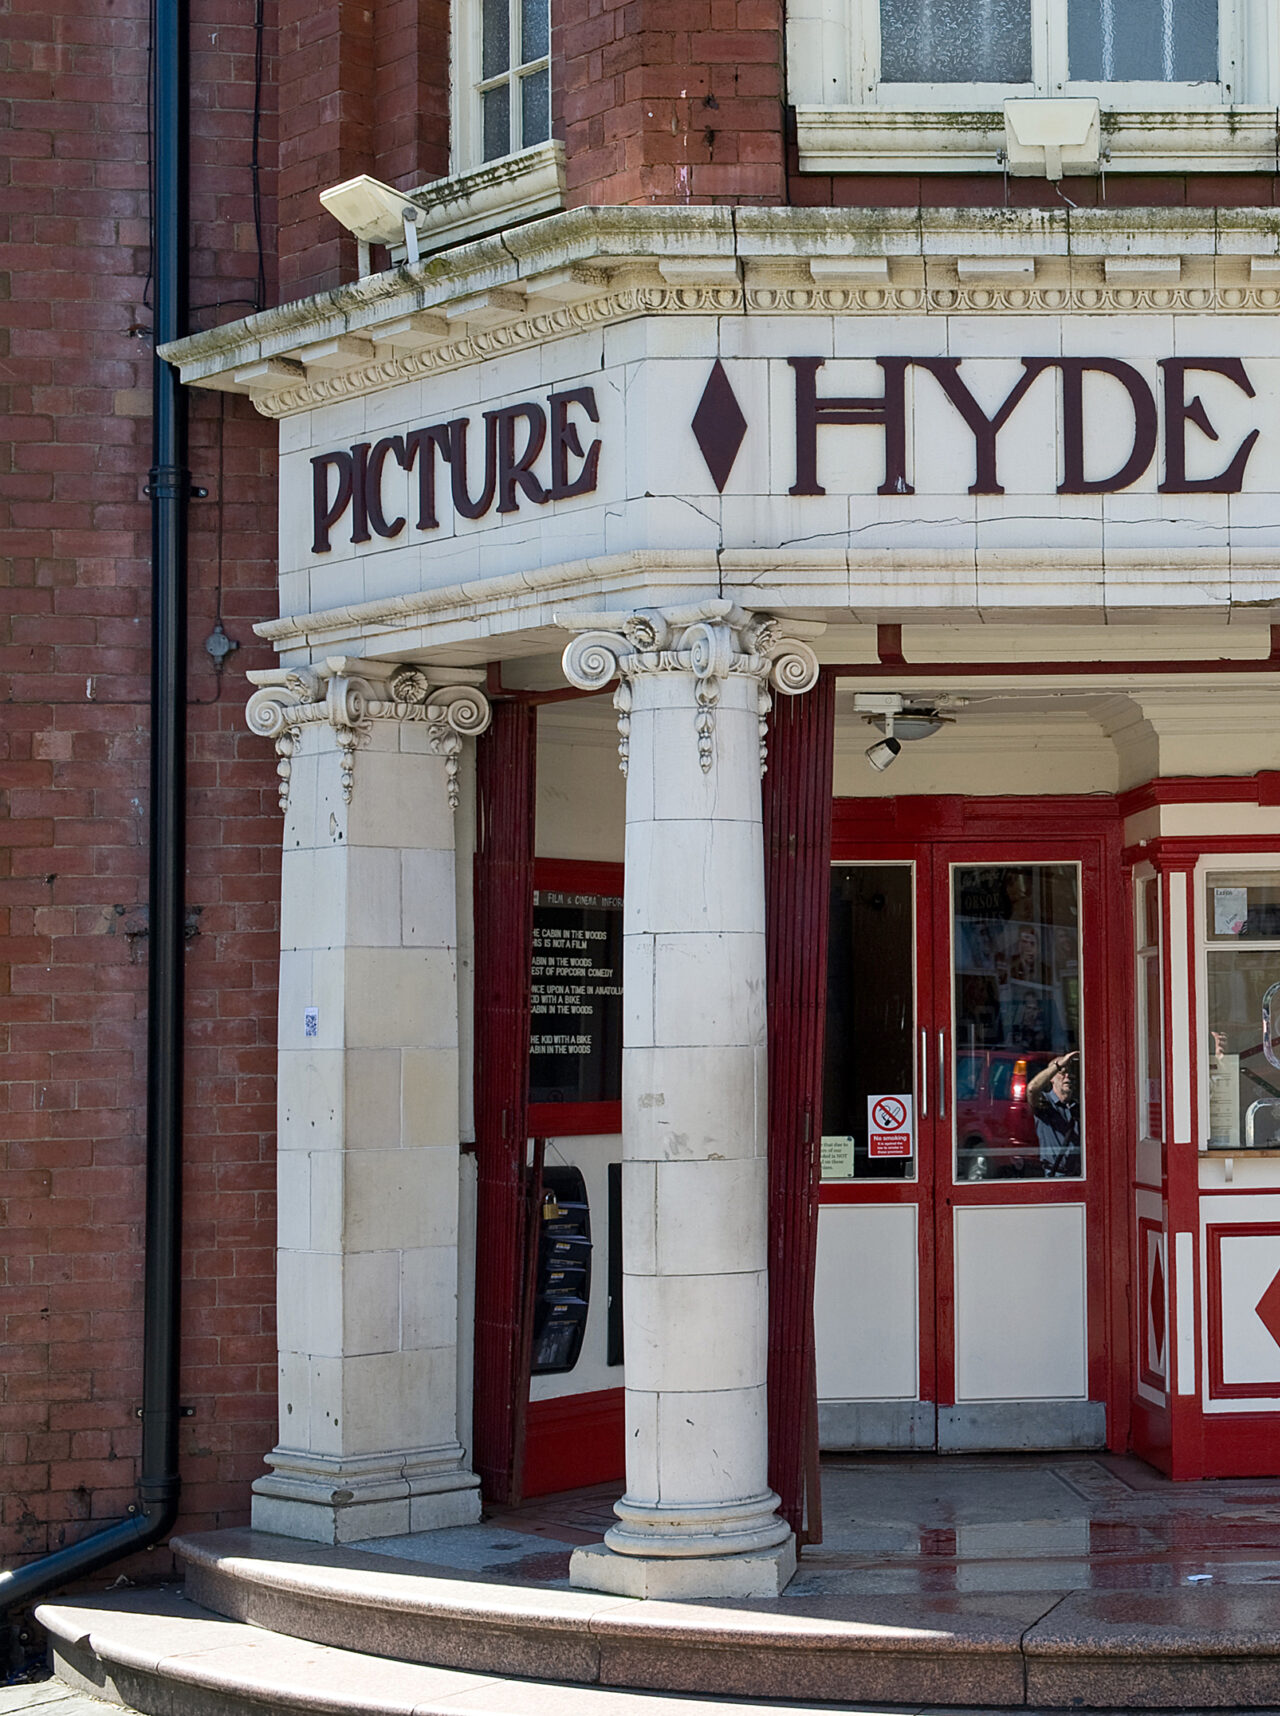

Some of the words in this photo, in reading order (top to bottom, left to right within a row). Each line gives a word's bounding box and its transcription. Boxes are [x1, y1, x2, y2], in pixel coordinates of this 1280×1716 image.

[788, 355, 1260, 497] HYDE
[309, 385, 602, 554] PICTURE
[547, 893, 564, 904] FILM
[574, 895, 597, 906] CINEMA
[601, 897, 624, 908] INFOR
[541, 929, 562, 938] CABIN
[563, 930, 570, 938] IN
[571, 930, 584, 939] THE
[585, 931, 607, 940] WOODS
[533, 939, 542, 947] HIS
[544, 939, 551, 948] IS
[552, 939, 565, 948] NOT
[565, 940, 571, 948] A
[572, 940, 588, 949] FILM
[531, 956, 547, 966] ABIN
[548, 957, 555, 966] IN
[556, 957, 568, 966] THE
[569, 958, 592, 967] WOODS
[531, 967, 544, 975] EST
[545, 967, 555, 976] OF
[555, 968, 586, 976] POPCORN
[587, 968, 613, 977] COMEDY
[530, 985, 545, 994] NCE
[546, 985, 564, 994] UPON
[564, 986, 570, 994] A
[570, 985, 585, 994] TIME
[587, 986, 593, 995] IN
[541, 995, 557, 1004] WITH
[558, 995, 563, 1004] A
[564, 995, 581, 1004] BIKE
[530, 1005, 547, 1014] ABIN
[548, 1005, 556, 1014] IN
[557, 1005, 570, 1014] THE
[570, 1005, 593, 1015] WOODS
[530, 1035, 540, 1044] HE
[541, 1035, 553, 1044] KID
[553, 1035, 570, 1044] WITH
[570, 1035, 576, 1044] A
[576, 1035, 592, 1044] BIKE
[529, 1045, 546, 1054] ABIN
[547, 1045, 554, 1054] IN
[554, 1045, 568, 1054] THE
[568, 1045, 591, 1054] WOODS
